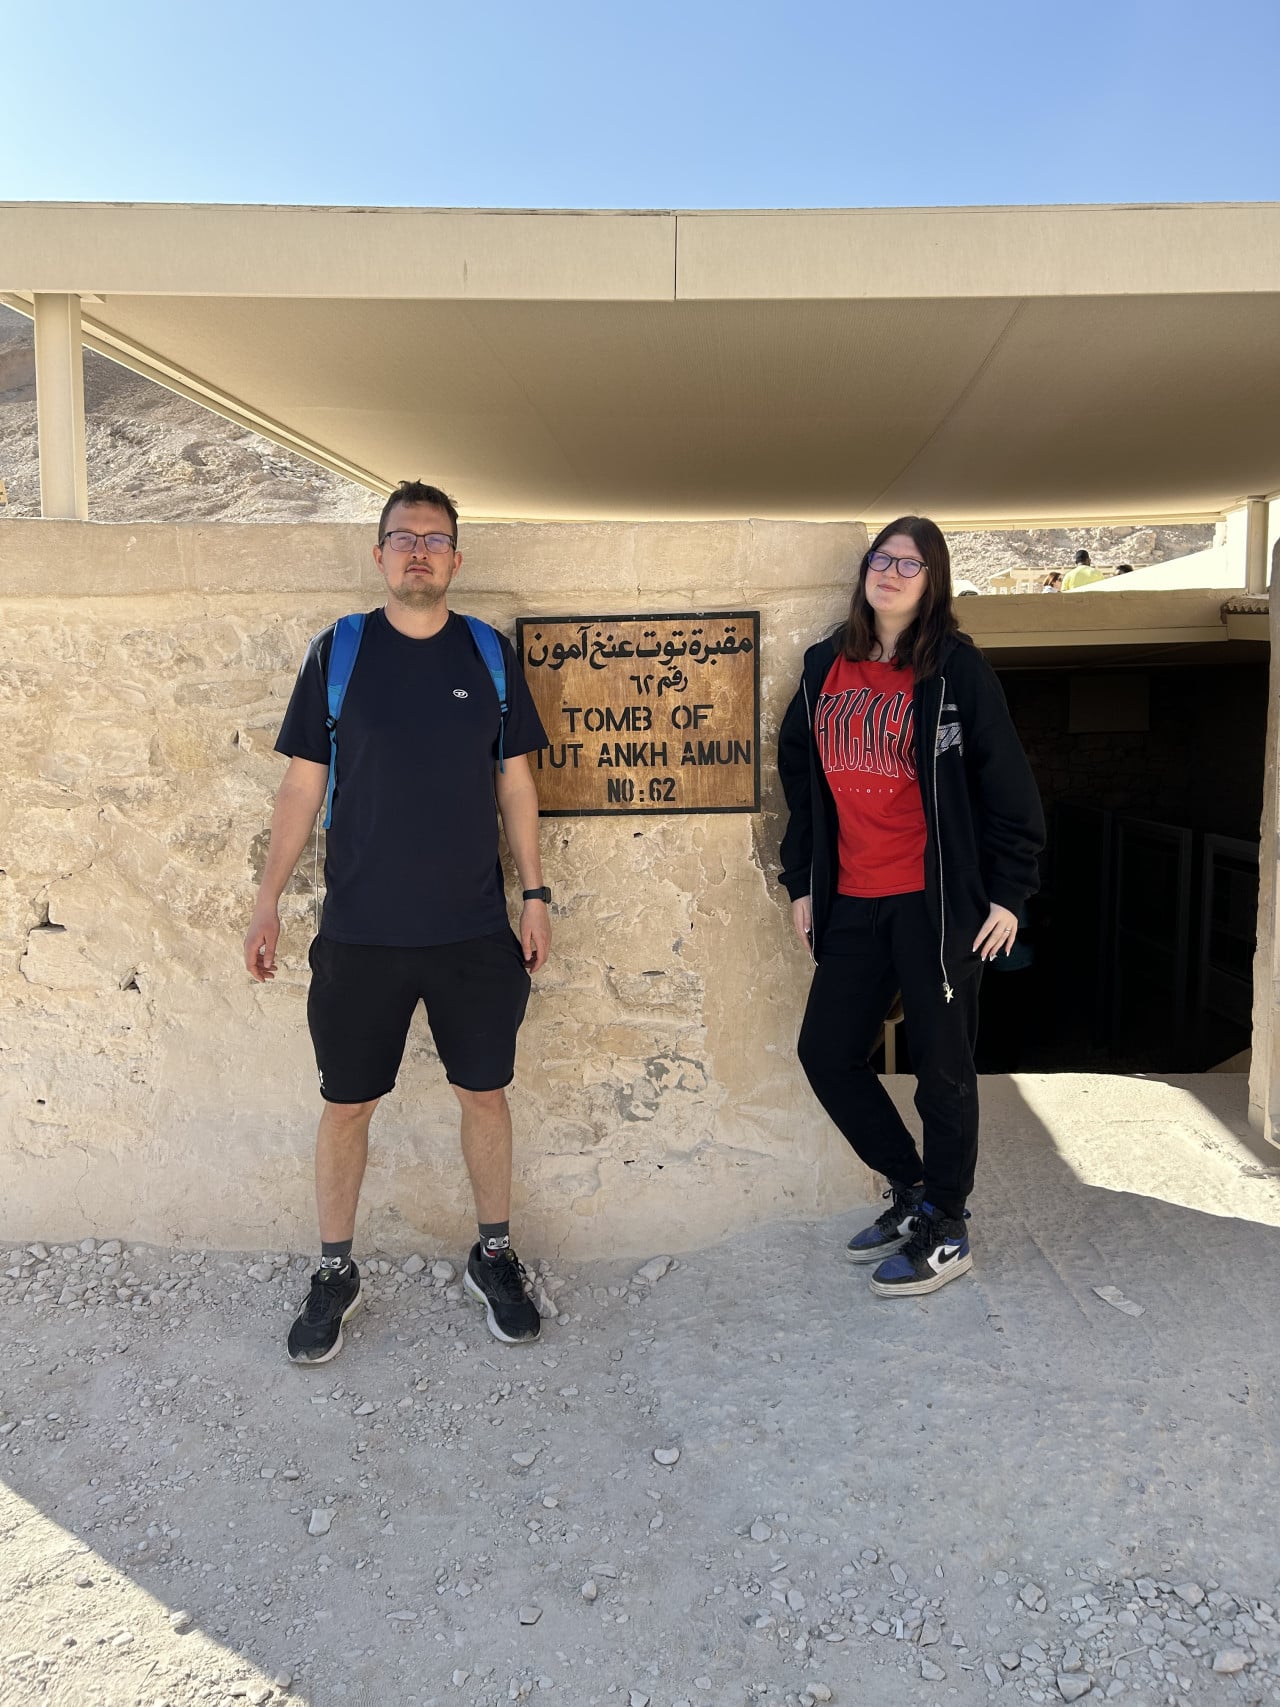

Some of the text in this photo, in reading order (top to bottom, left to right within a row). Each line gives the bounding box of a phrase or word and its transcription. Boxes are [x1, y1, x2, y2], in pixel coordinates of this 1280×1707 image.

[527, 624, 753, 670] مقبرة توت عنخ آمون
[657, 665, 689, 697] رقم
[562, 704, 714, 732] TOMB OF
[815, 687, 918, 780] HICAGO
[597, 741, 668, 767] ANKH
[681, 739, 750, 766] AMUN
